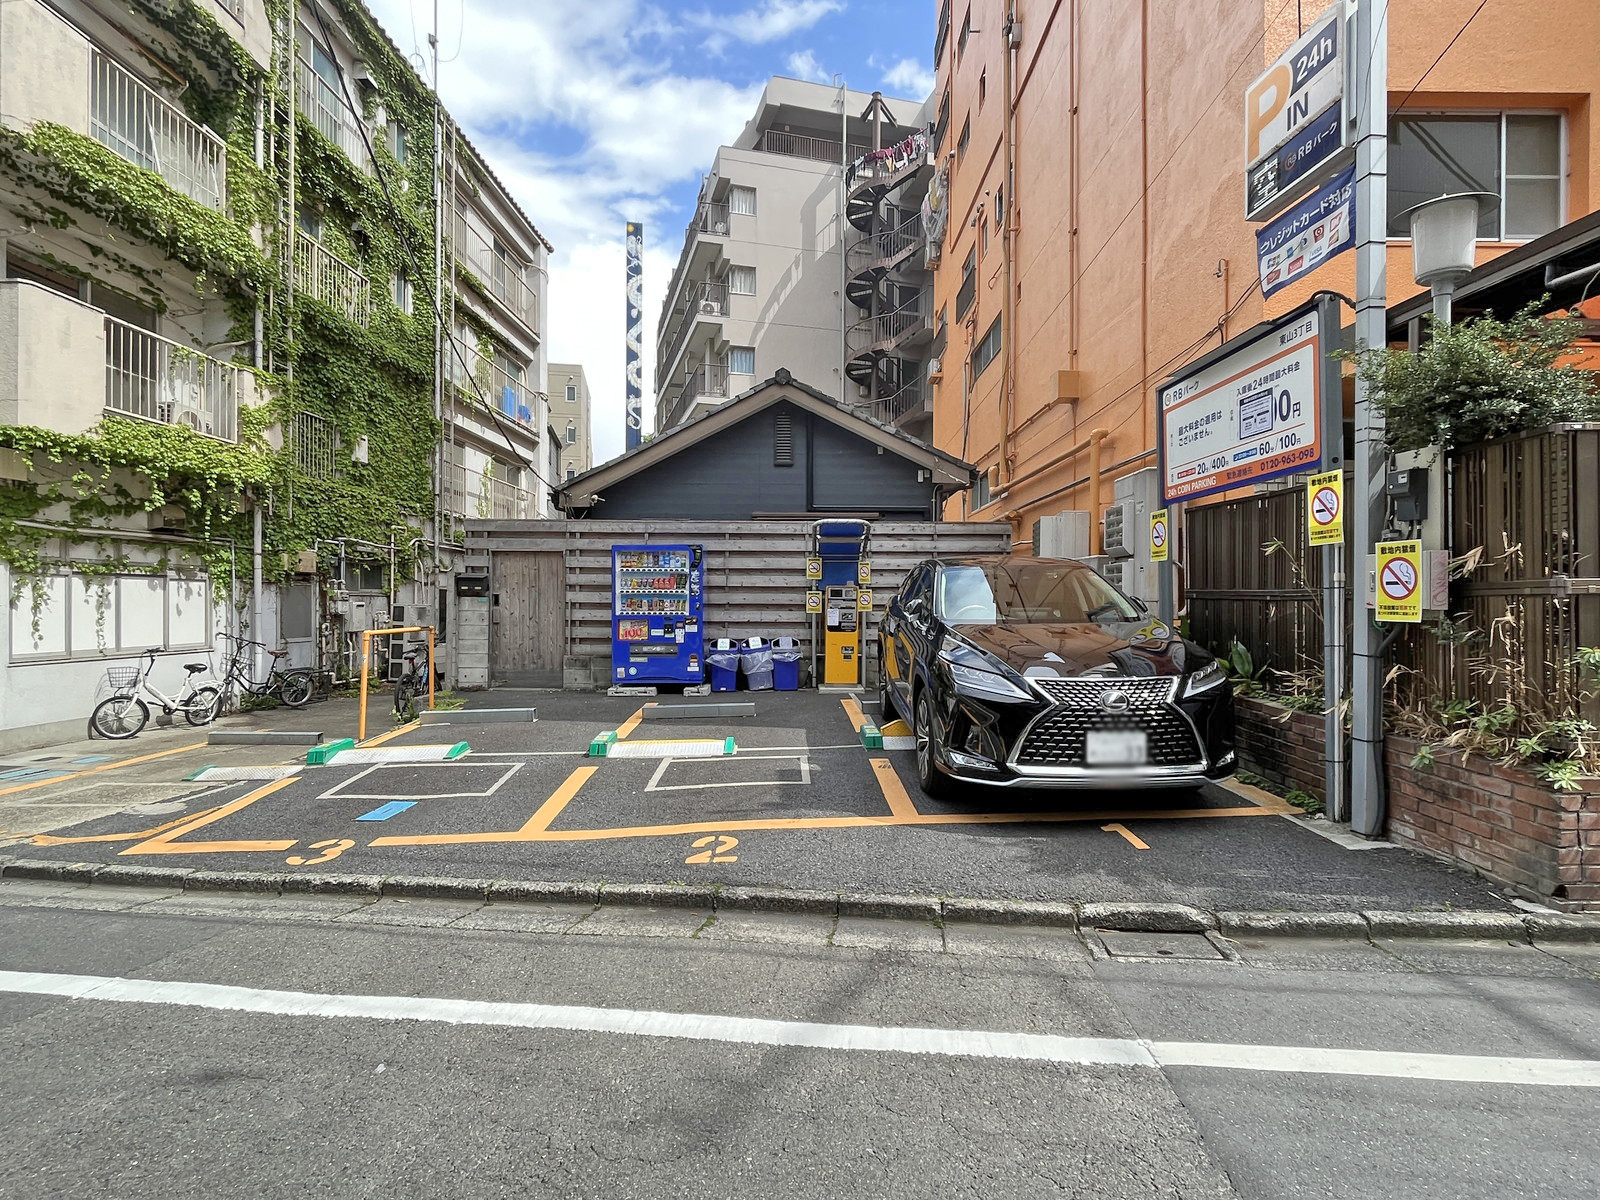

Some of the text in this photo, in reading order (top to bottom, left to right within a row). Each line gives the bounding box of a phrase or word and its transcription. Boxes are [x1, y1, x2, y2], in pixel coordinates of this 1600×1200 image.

[1296, 36, 1333, 83] 24h
[1247, 64, 1293, 164] P
[1286, 91, 1309, 132] IN
[1297, 121, 1338, 161] RBパーク
[1253, 157, 1279, 209] 空
[1260, 182, 1353, 255] クレジットカード対応
[1279, 320, 1312, 347] 東山3丁目
[1173, 381, 1199, 402] RBパーク
[1261, 448, 1314, 471] 0120-963-098
[1177, 483, 1191, 495] COIN
[1191, 476, 1217, 491] PARKING
[1380, 544, 1416, 555] 敷地内禁煙
[285, 838, 356, 865] 3
[685, 835, 739, 864] 2
